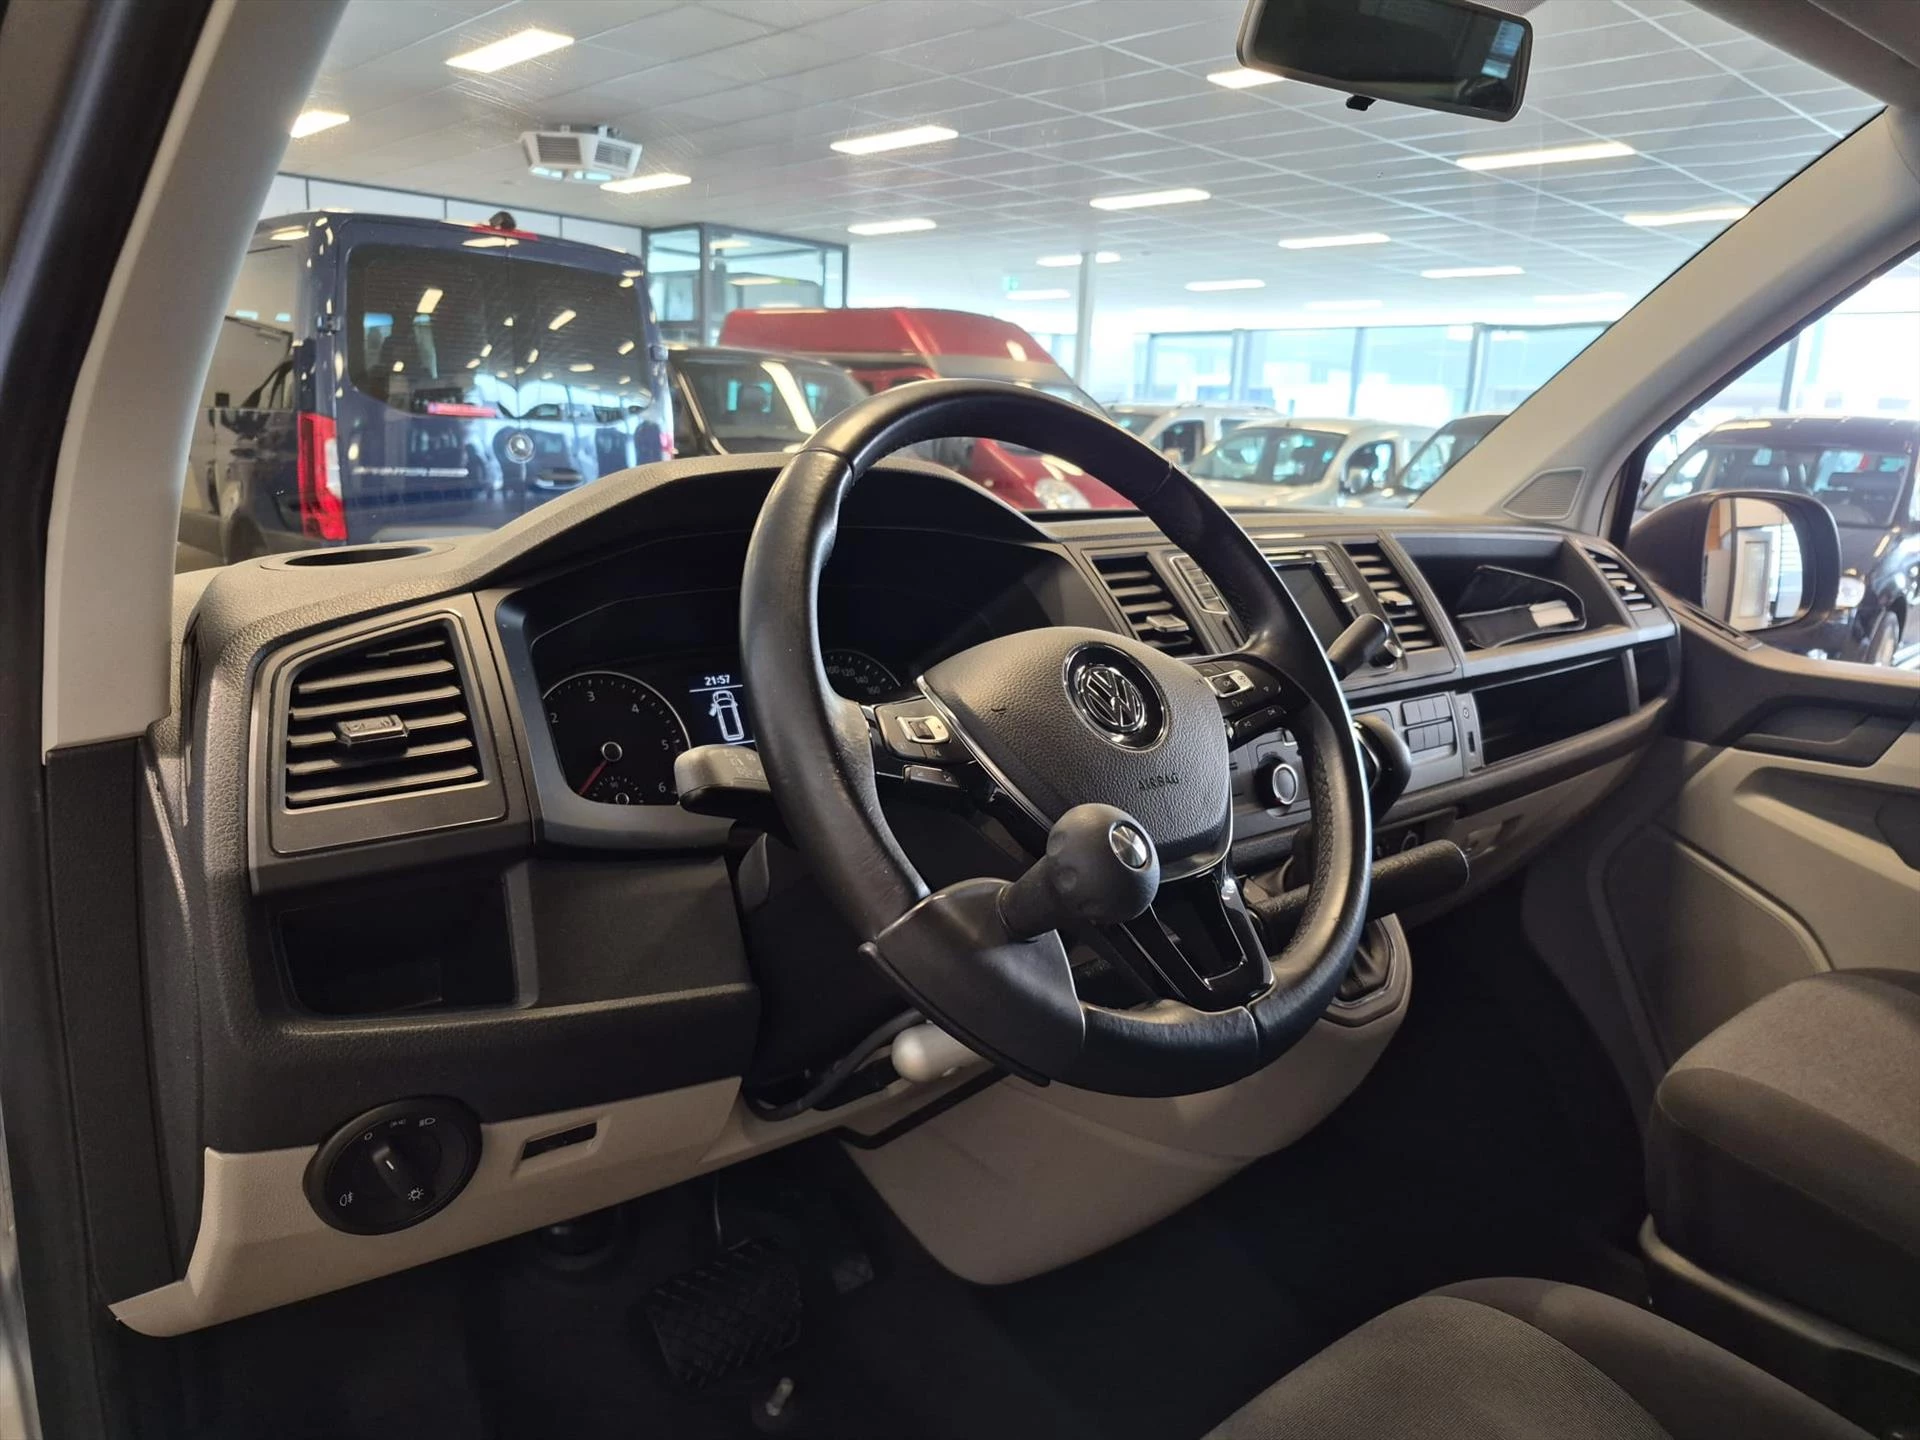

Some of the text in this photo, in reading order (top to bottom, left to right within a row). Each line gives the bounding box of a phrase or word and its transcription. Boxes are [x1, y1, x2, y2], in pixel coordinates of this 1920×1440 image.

[704, 674, 731, 686] 21:57
[587, 691, 596, 701] 3
[631, 703, 640, 713] 4
[550, 712, 559, 723] 2
[661, 739, 670, 750] 5
[658, 782, 667, 792] 6
